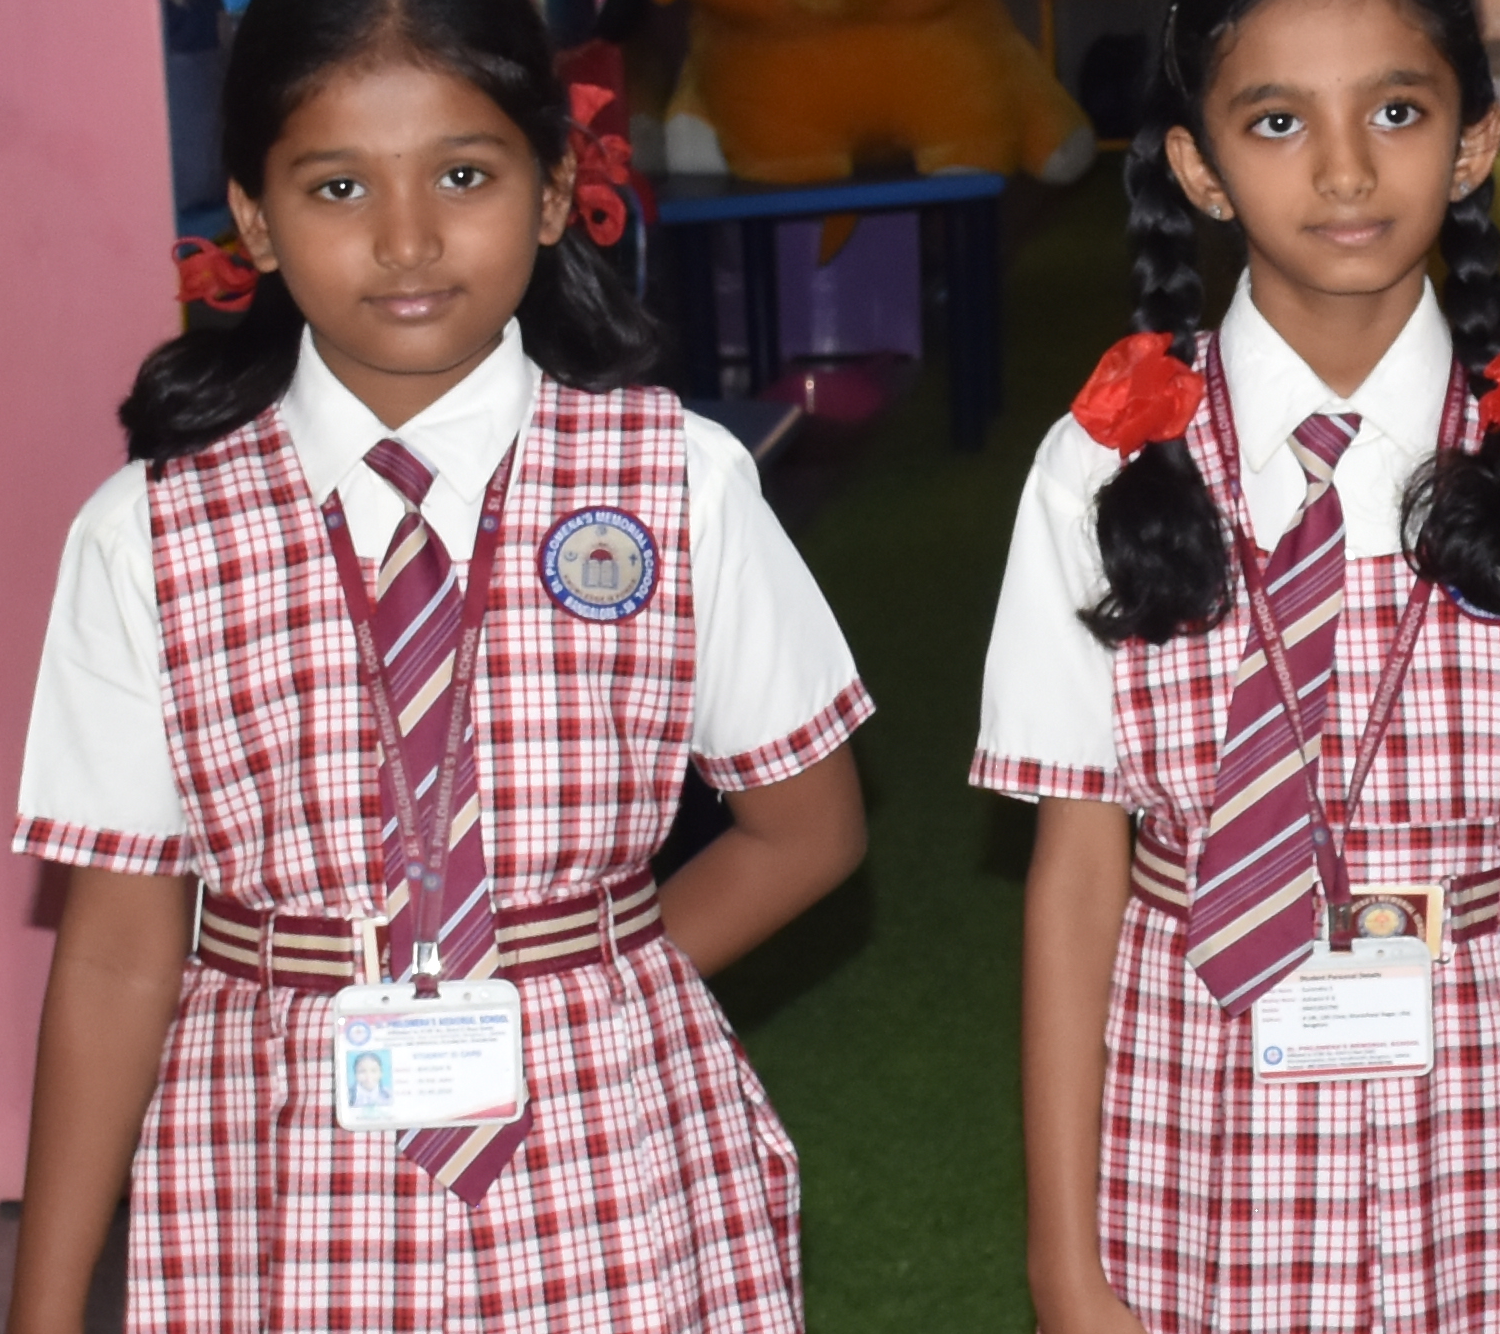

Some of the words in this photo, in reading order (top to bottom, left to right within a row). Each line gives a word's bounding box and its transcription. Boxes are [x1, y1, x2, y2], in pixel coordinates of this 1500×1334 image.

[357, 620, 380, 674] SCHOOL
[1253, 588, 1277, 641] SCHOOL
[1269, 641, 1298, 711] MEMORIAL
[1375, 656, 1403, 723] MEMORIAL
[1397, 602, 1424, 652] SCHOOL
[370, 676, 397, 746] MEMORIAL
[431, 756, 457, 847] PHILOMENA'S
[447, 683, 468, 754] MEMORIAL
[458, 627, 477, 680] SCHOOL
[386, 747, 415, 837] PHILOMENA'S
